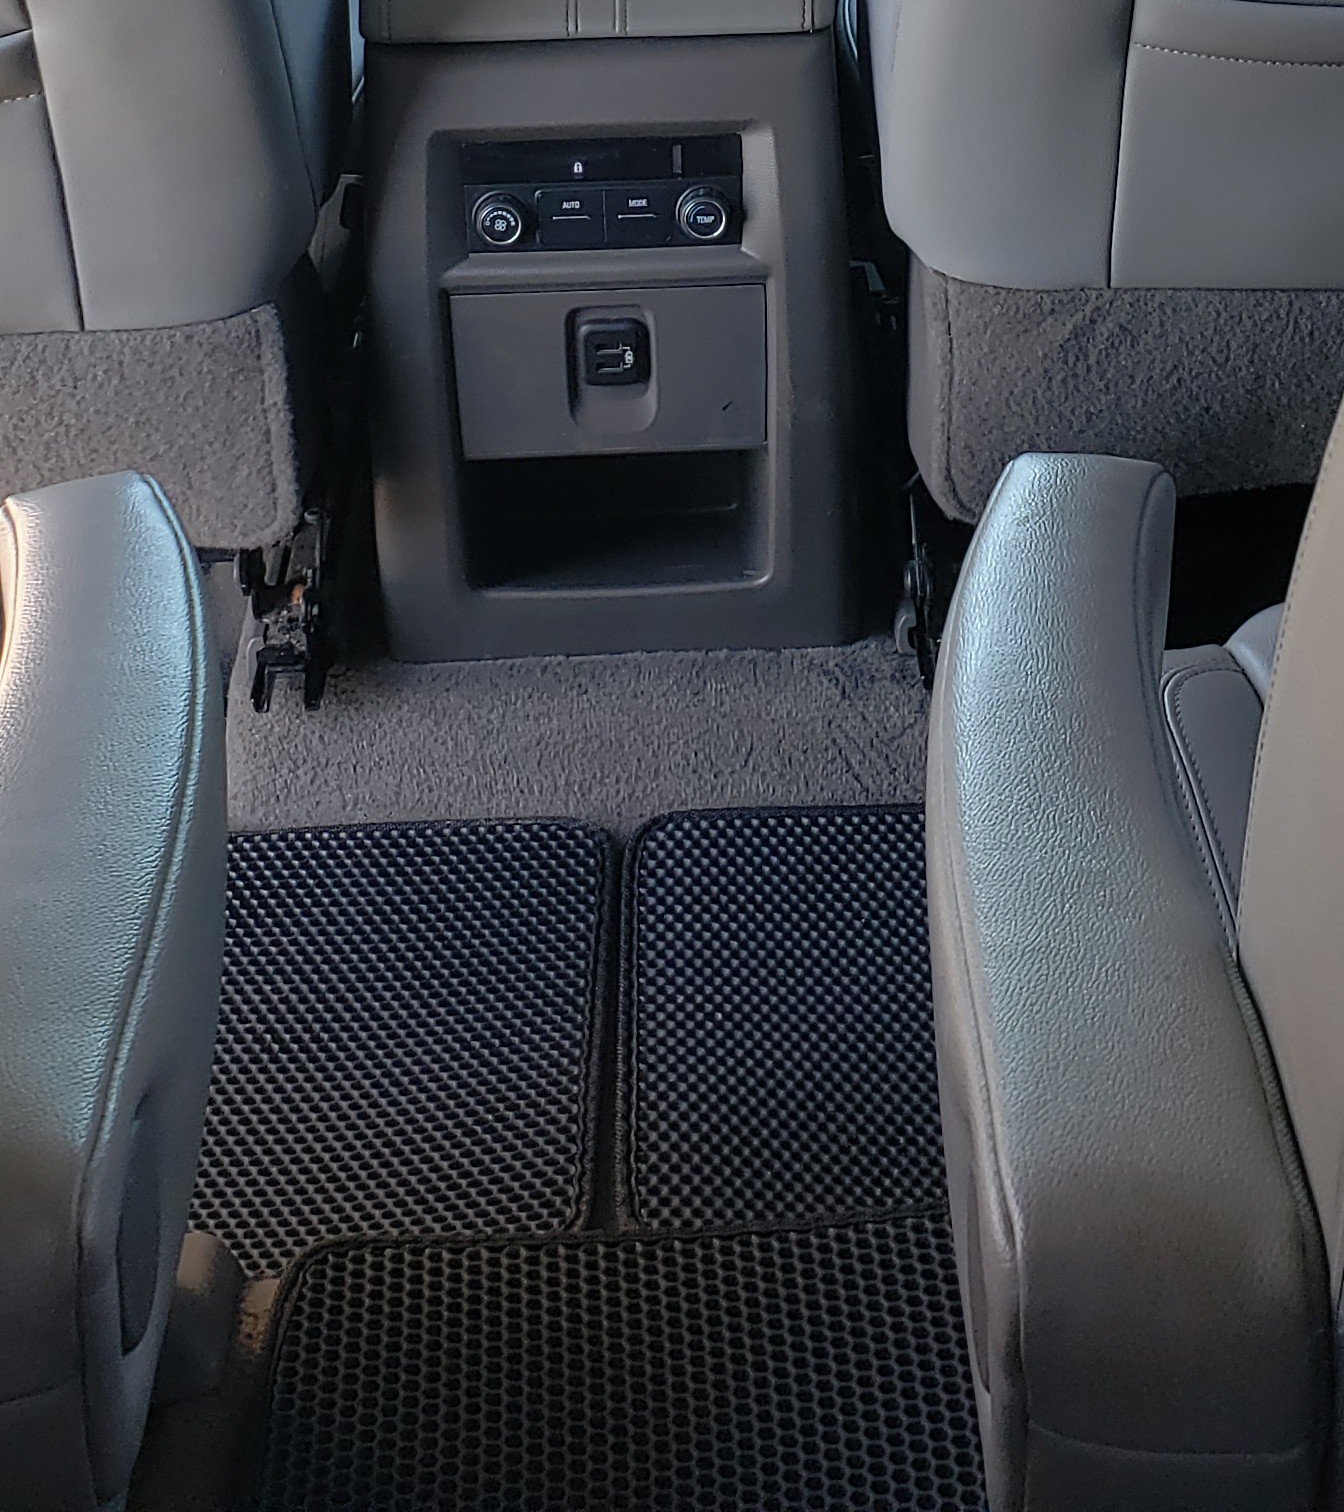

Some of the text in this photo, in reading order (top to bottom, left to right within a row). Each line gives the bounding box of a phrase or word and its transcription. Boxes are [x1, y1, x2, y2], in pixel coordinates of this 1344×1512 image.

[562, 201, 581, 210] AUTO
[628, 198, 649, 208] MODE
[696, 215, 716, 225] TEMP
